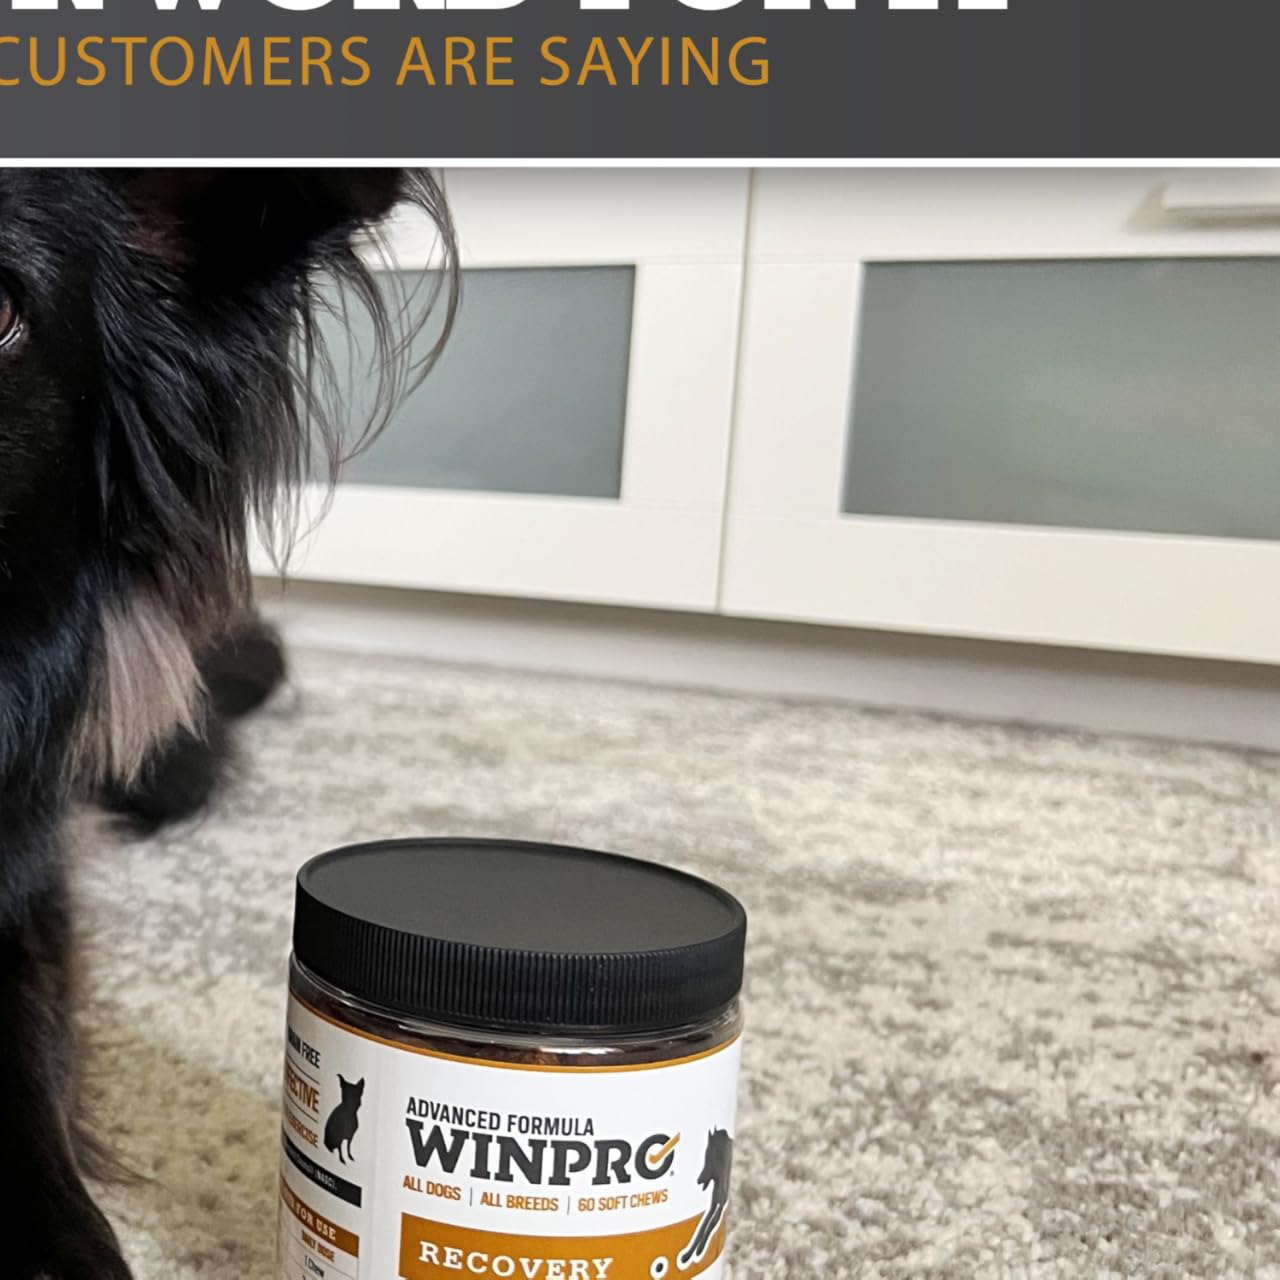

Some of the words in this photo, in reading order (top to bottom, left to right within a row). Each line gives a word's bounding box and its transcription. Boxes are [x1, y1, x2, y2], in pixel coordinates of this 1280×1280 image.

[406, 1096, 501, 1131] ADVANCED
[507, 1114, 595, 1137] FORMULA
[405, 1118, 677, 1187] WINPRO
[403, 1175, 423, 1194] ALL
[426, 1183, 462, 1202] DOGS
[480, 1191, 503, 1208] ALL
[506, 1194, 559, 1212] BREEDS
[577, 1198, 595, 1212] 60
[598, 1195, 628, 1211] SOFT
[630, 1188, 669, 1208] CHEWS
[316, 1218, 336, 1240] USE
[418, 1240, 614, 1280] RECOVERY
